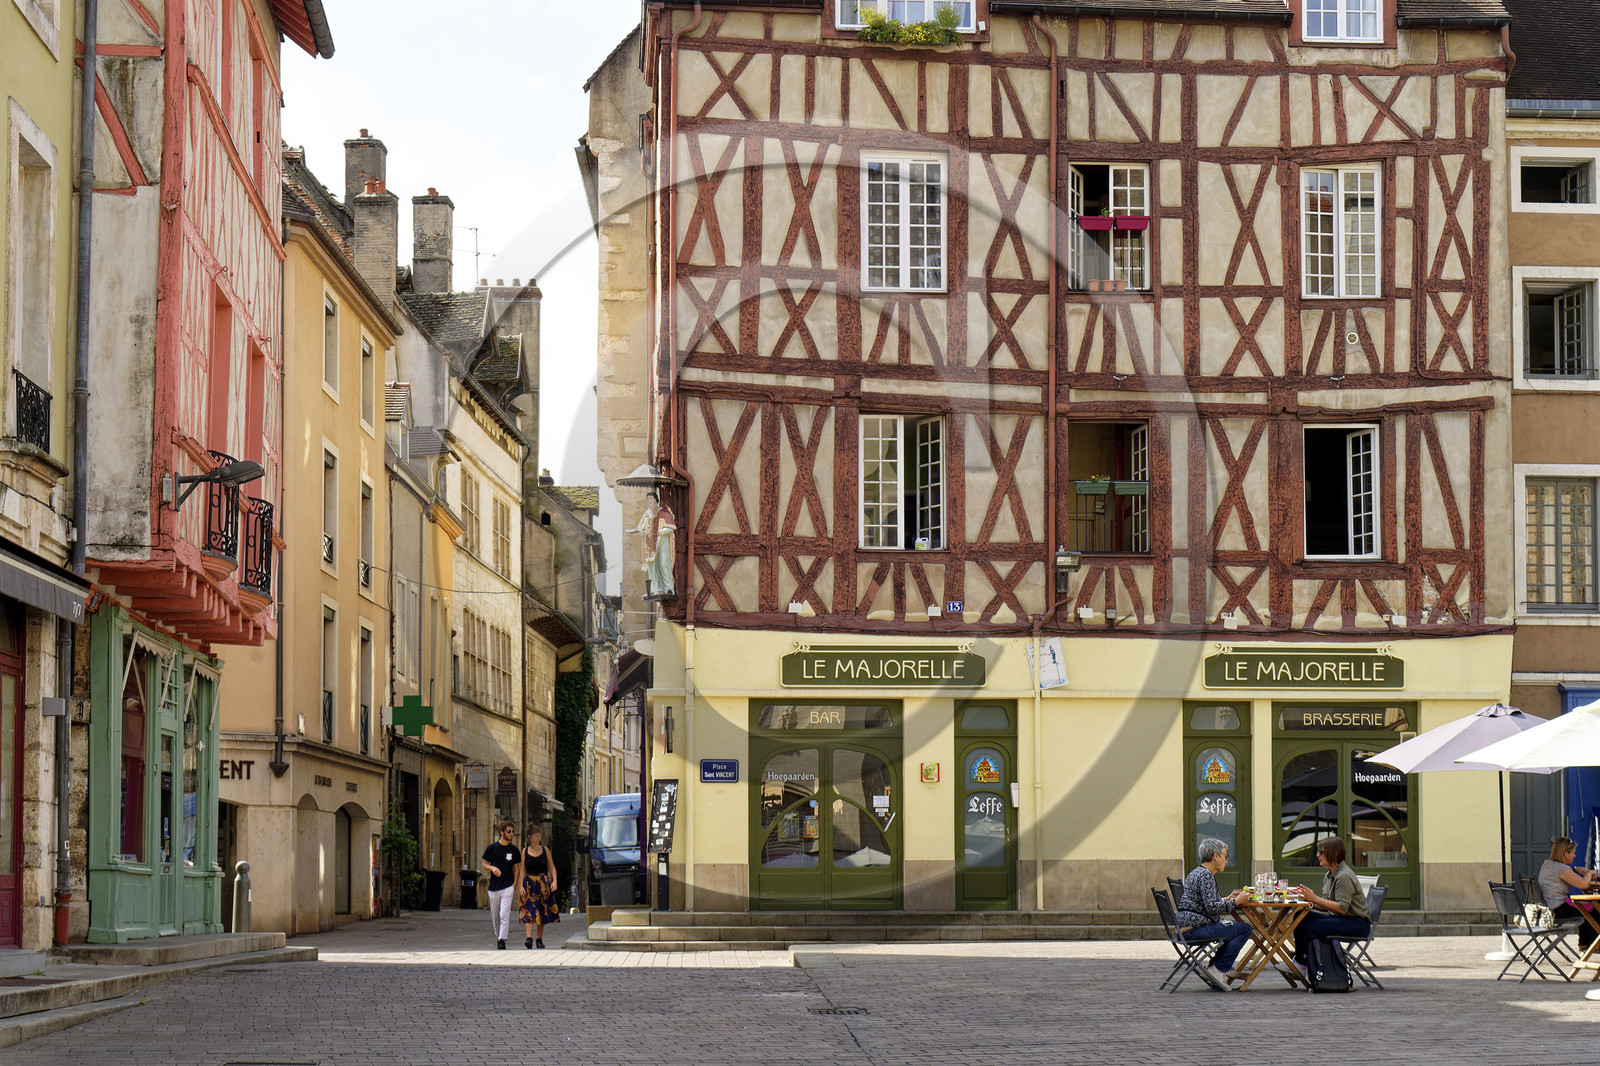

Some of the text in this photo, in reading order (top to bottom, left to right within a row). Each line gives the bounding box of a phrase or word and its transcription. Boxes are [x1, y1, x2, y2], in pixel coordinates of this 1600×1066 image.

[949, 602, 960, 611] 13
[803, 659, 965, 680] LE MAJORELLE
[1225, 661, 1385, 682] LE MAJORELLE
[809, 711, 841, 725] BAR
[1303, 713, 1383, 727] BRASSERIE
[767, 771, 815, 782] Hoegaarden
[1354, 772, 1401, 784] Hoegaarden
[968, 796, 1003, 815] Leffe
[1199, 797, 1234, 816] Leffe
